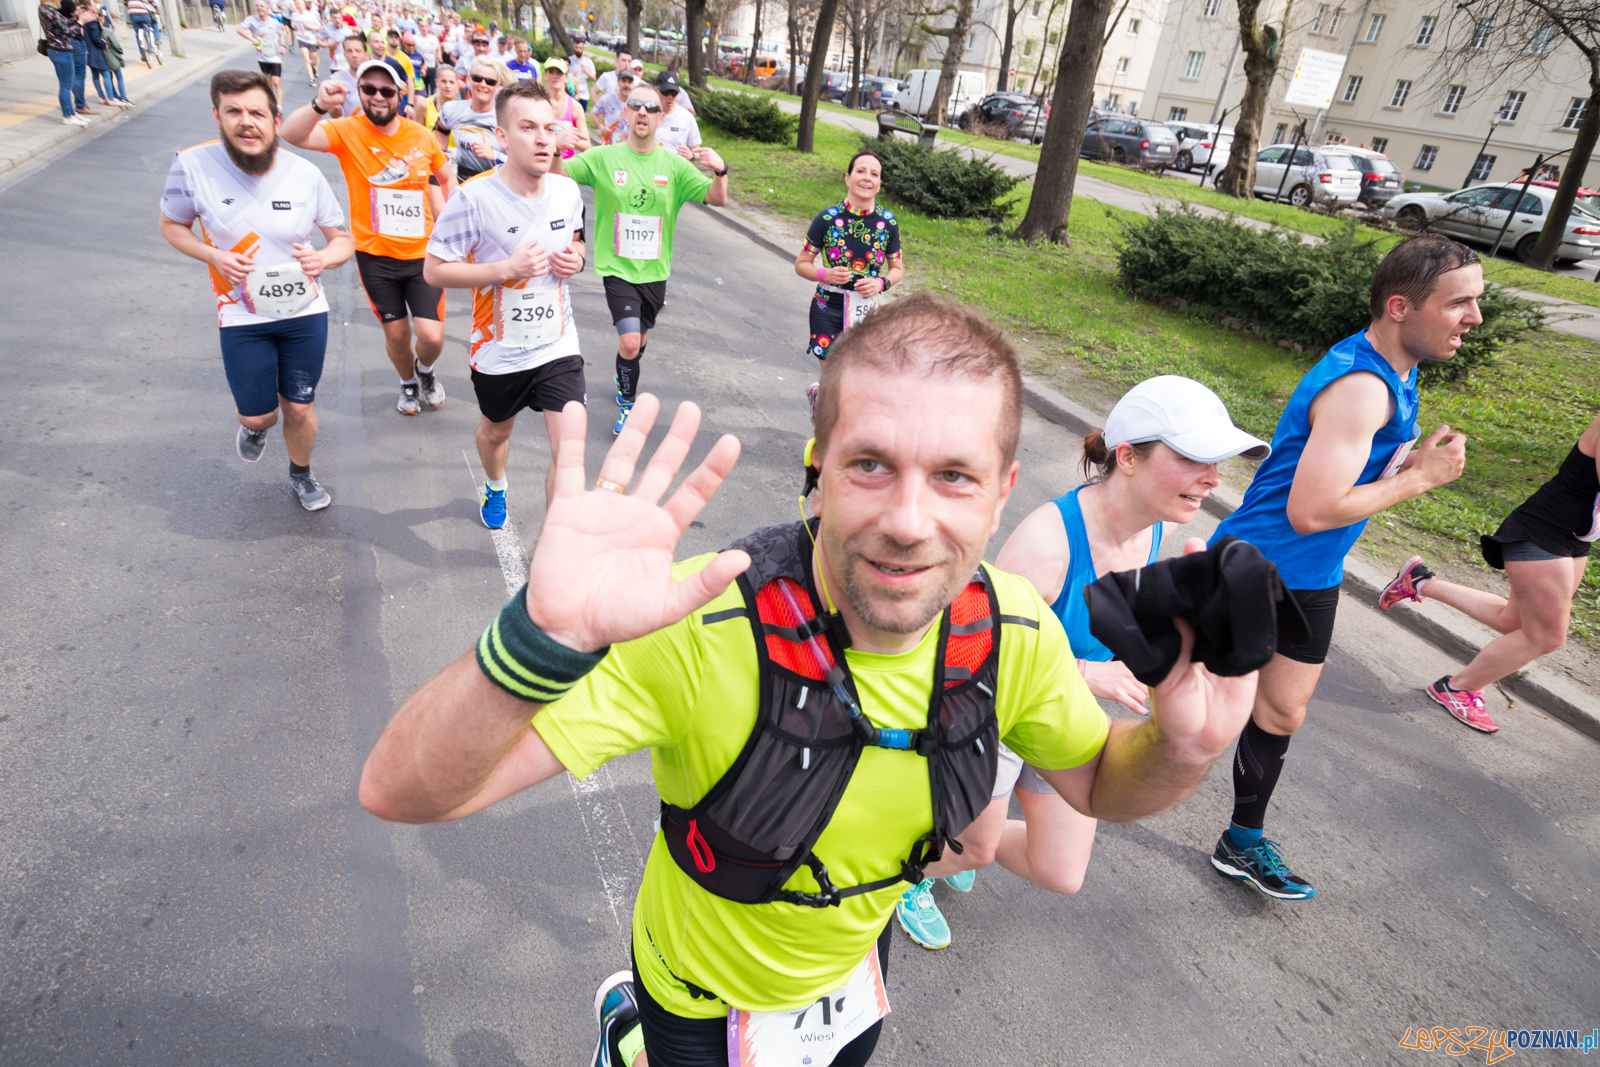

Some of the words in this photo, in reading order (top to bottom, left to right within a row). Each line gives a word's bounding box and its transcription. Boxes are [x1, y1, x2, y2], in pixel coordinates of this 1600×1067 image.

[382, 203, 421, 218] 11463
[507, 226, 519, 234] 4F
[624, 228, 655, 242] 11197
[259, 282, 306, 298] 4893
[511, 304, 555, 323] 2396
